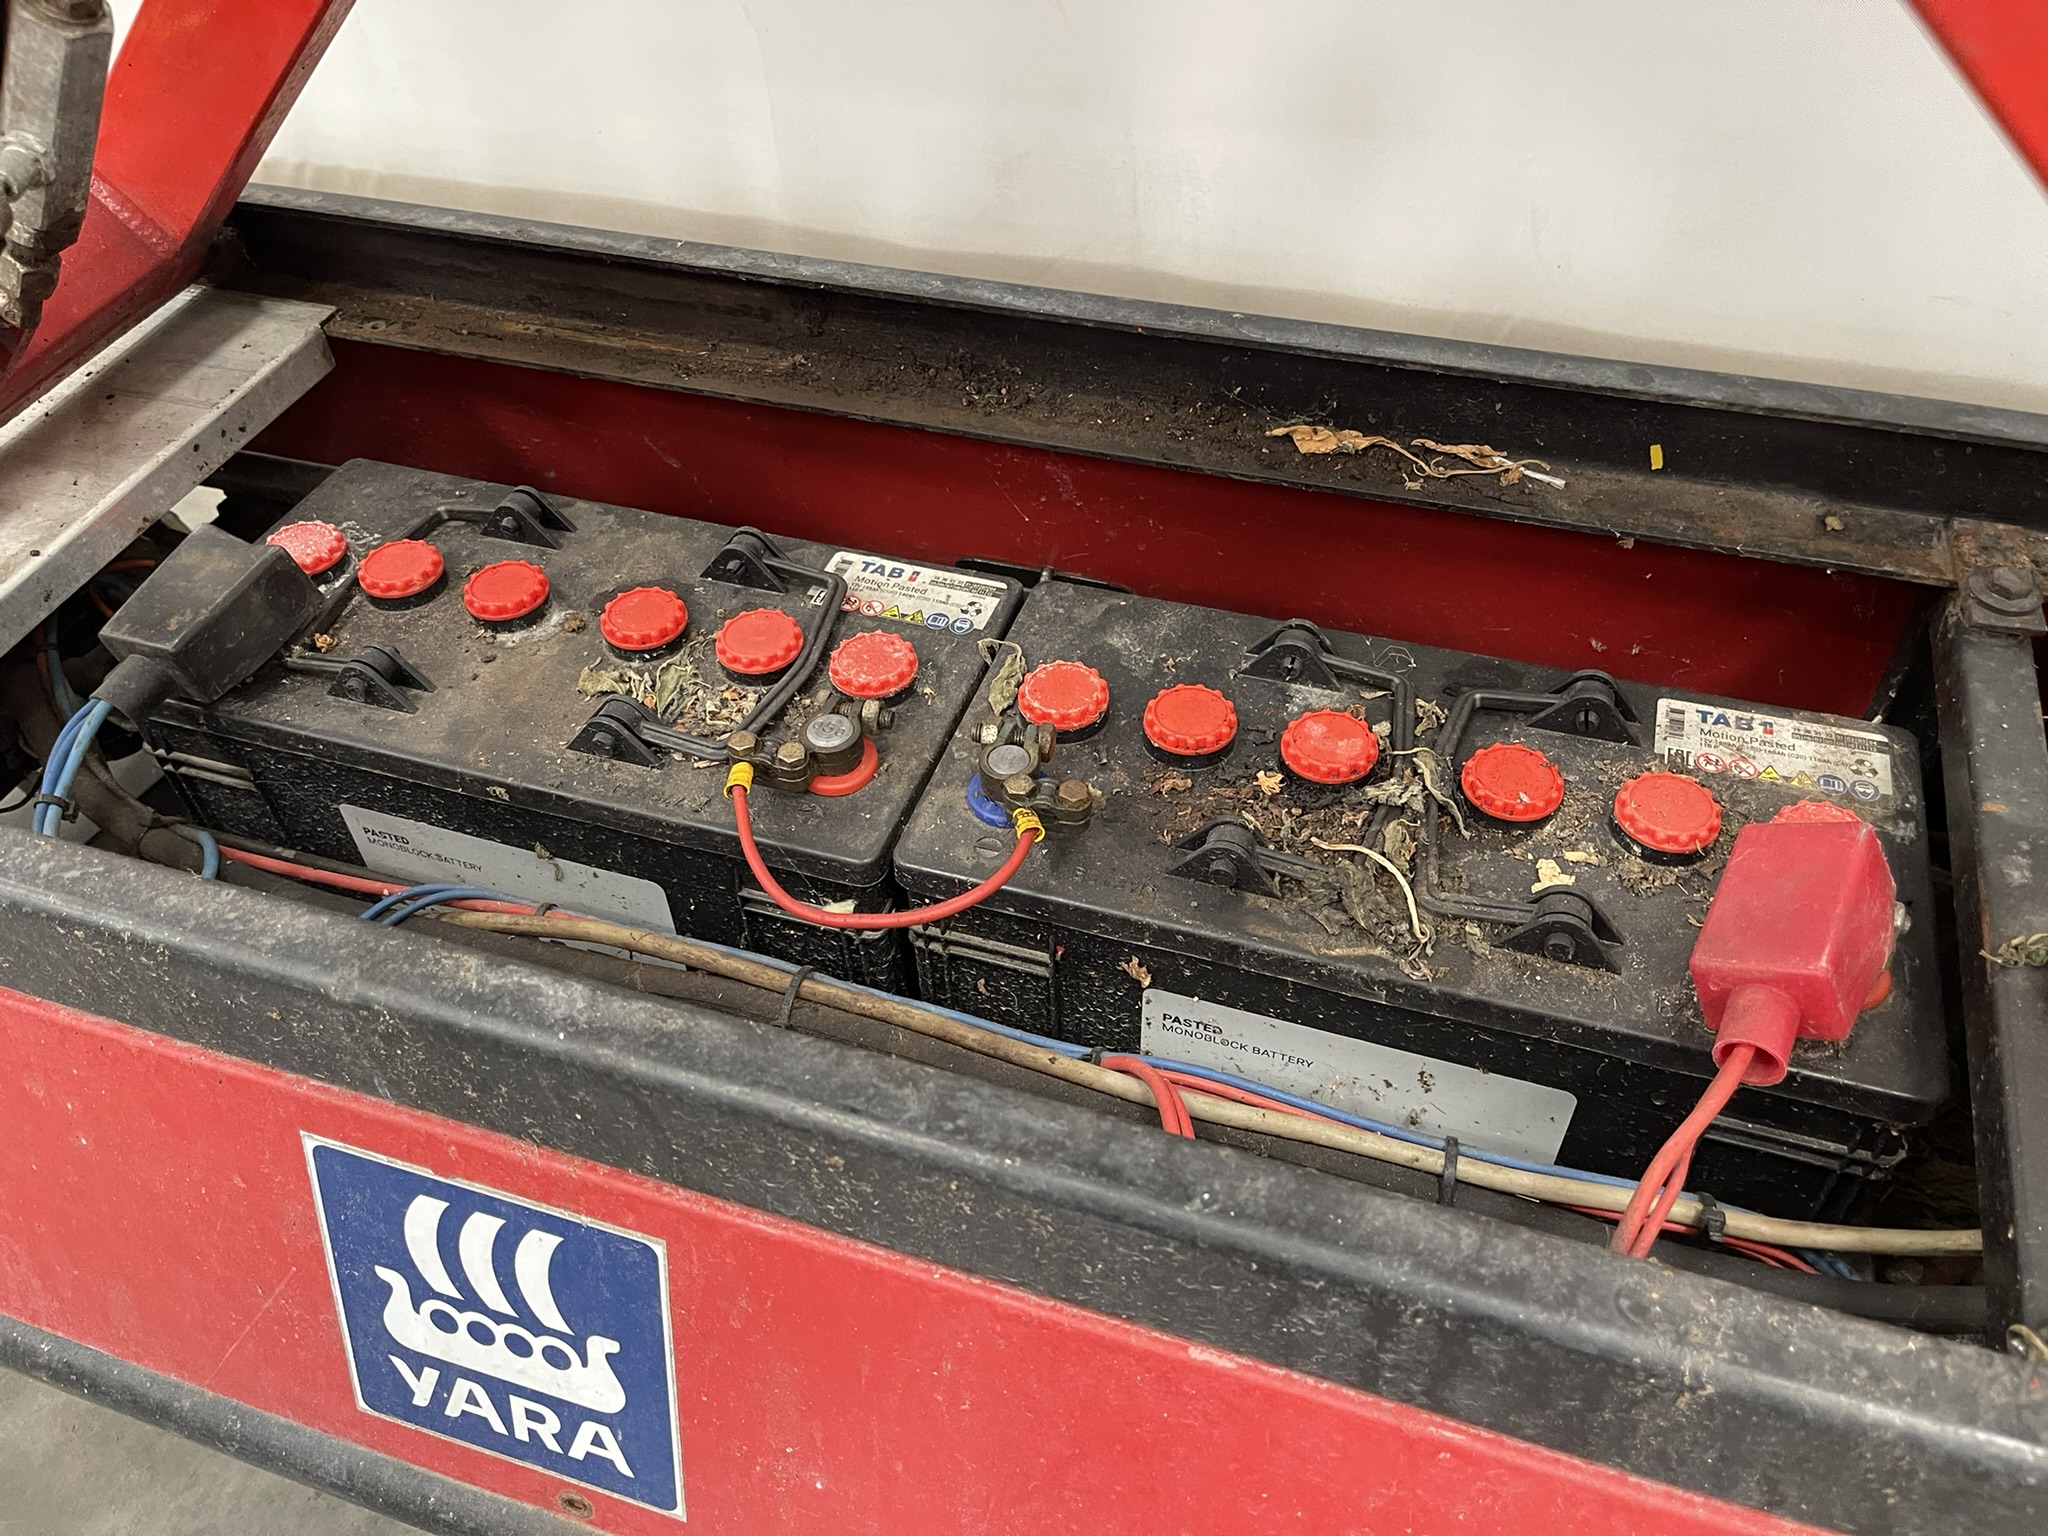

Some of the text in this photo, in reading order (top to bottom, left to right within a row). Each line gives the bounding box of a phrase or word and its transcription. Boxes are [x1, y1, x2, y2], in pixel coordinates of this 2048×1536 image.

[861, 561, 905, 579] TAB
[854, 575, 890, 588] Motion
[891, 582, 928, 595] Pasted
[1696, 710, 1754, 731] TAB
[1699, 728, 1796, 752] Motion Pasted
[362, 826, 410, 845] PASTED
[367, 837, 435, 859] MONOBLOCK
[1162, 1012, 1223, 1035] PASTED
[1161, 1023, 1314, 1069] MONOBLOCK BATTERY
[387, 1353, 636, 1479] YARA
